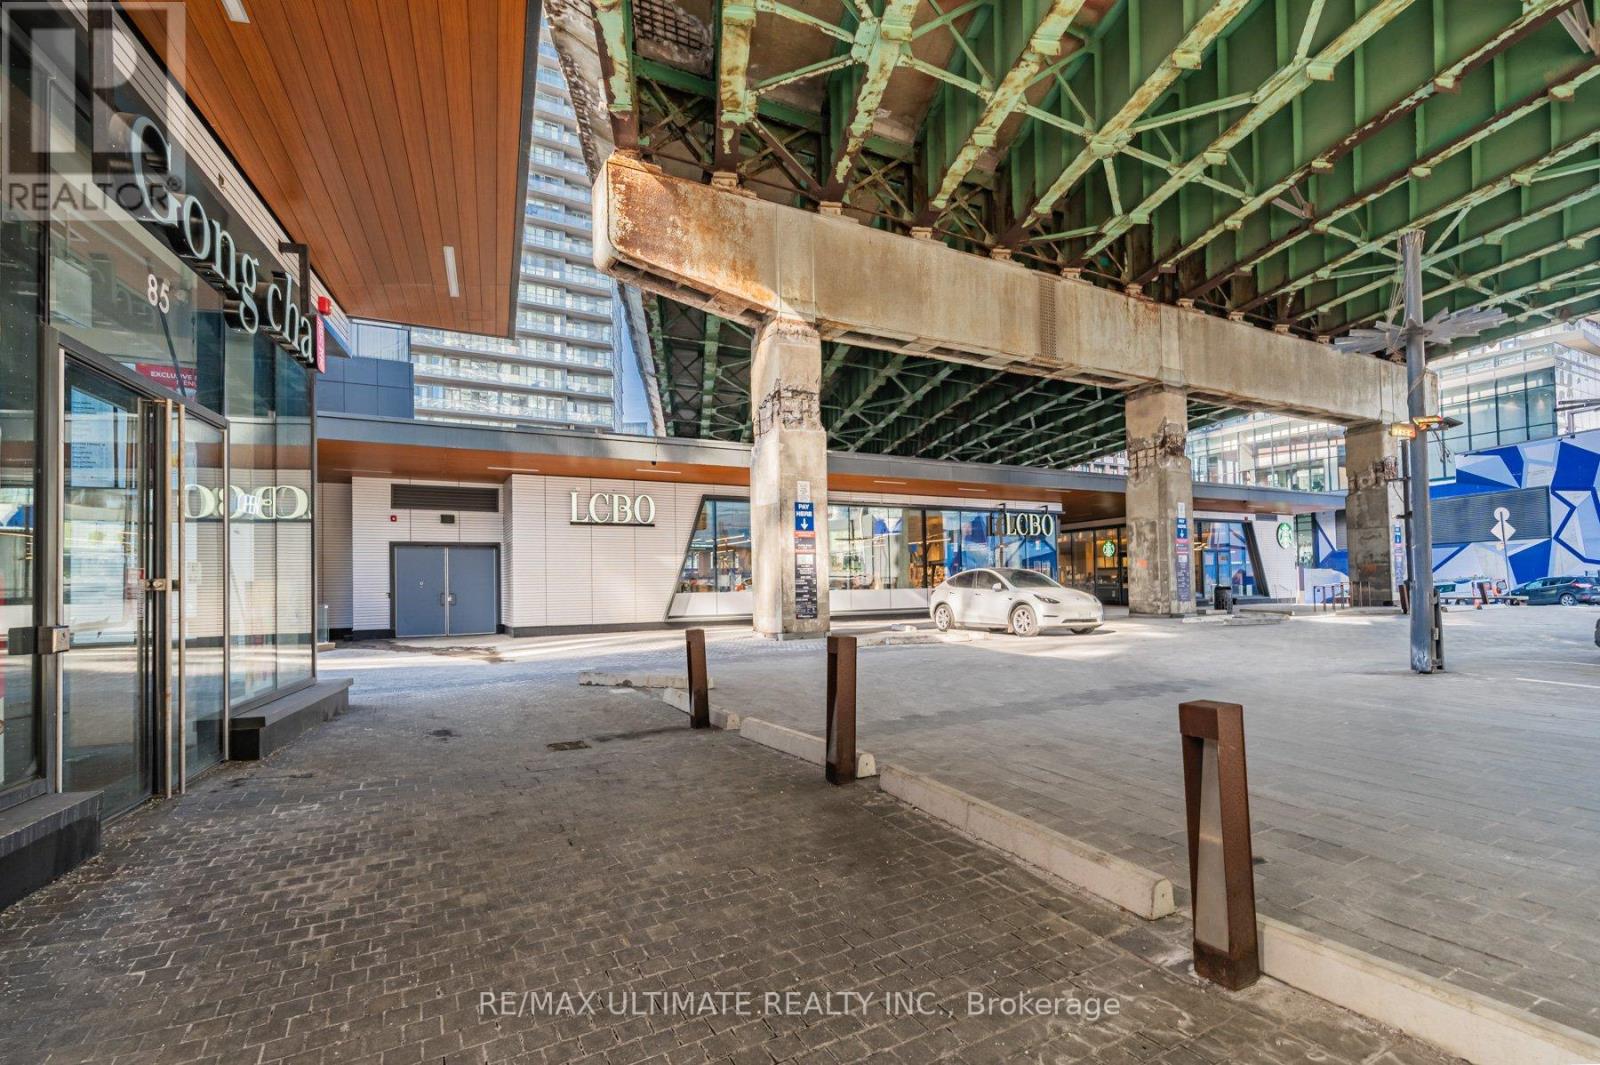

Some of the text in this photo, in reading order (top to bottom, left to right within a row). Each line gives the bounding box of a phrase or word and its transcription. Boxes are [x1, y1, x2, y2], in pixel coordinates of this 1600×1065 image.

[131, 116, 314, 364] Gong cha
[148, 274, 170, 314] 85
[570, 491, 656, 523] LCBO
[1005, 512, 1054, 537] LCBO
